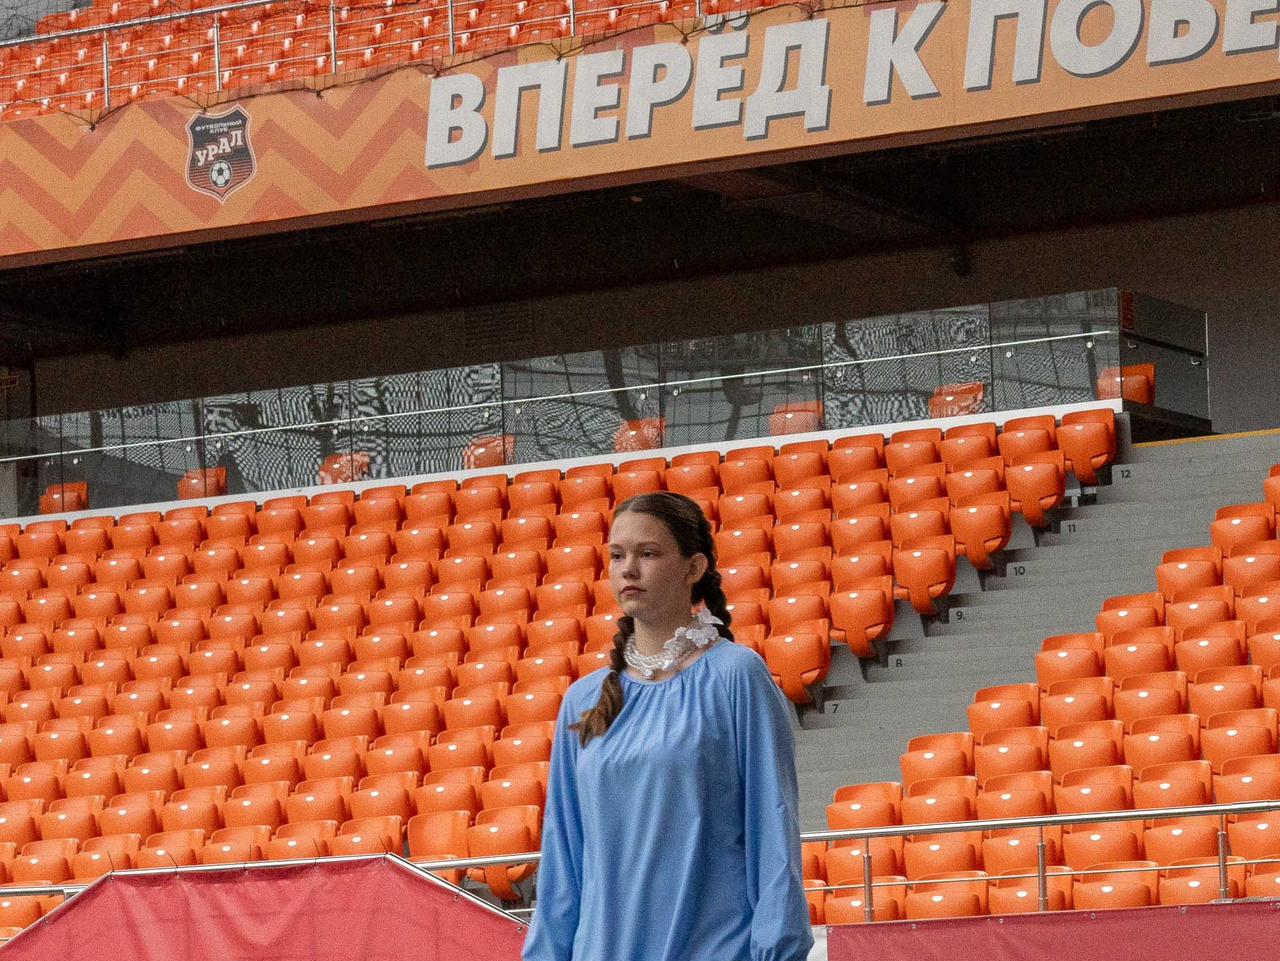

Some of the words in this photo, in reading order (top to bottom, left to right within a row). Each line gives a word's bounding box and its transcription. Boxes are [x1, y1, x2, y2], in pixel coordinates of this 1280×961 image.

[425, 11, 831, 170] ВПЕРЁД
[863, 1, 948, 106] К
[195, 130, 243, 166] УРАЛ
[1120, 470, 1131, 479] 12
[1067, 524, 1076, 533] 11
[1013, 566, 1026, 576] 10
[895, 658, 903, 668] 8
[831, 703, 839, 714] 7
